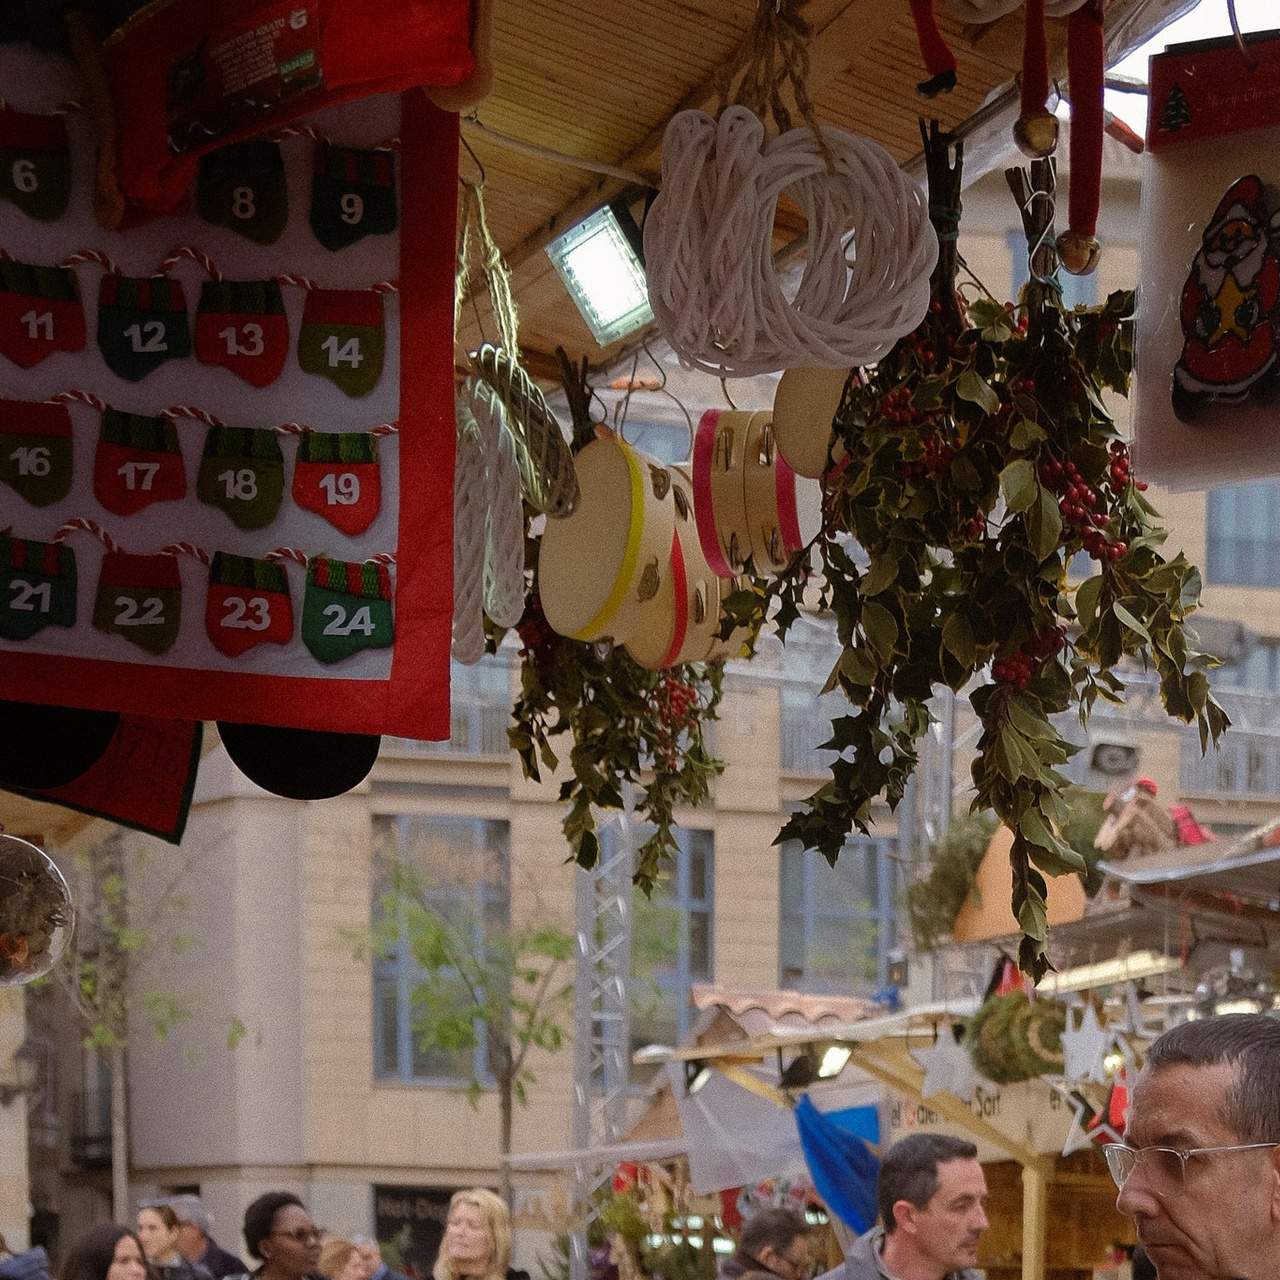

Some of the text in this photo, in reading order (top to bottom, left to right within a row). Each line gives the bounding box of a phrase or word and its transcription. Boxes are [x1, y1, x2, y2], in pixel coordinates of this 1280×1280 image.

[13, 160, 364, 225] 6 8 9
[20, 311, 364, 369] 11 12 13 14
[9, 446, 361, 505] 16 17 18 19
[9, 579, 376, 636] 21 22 23 24
